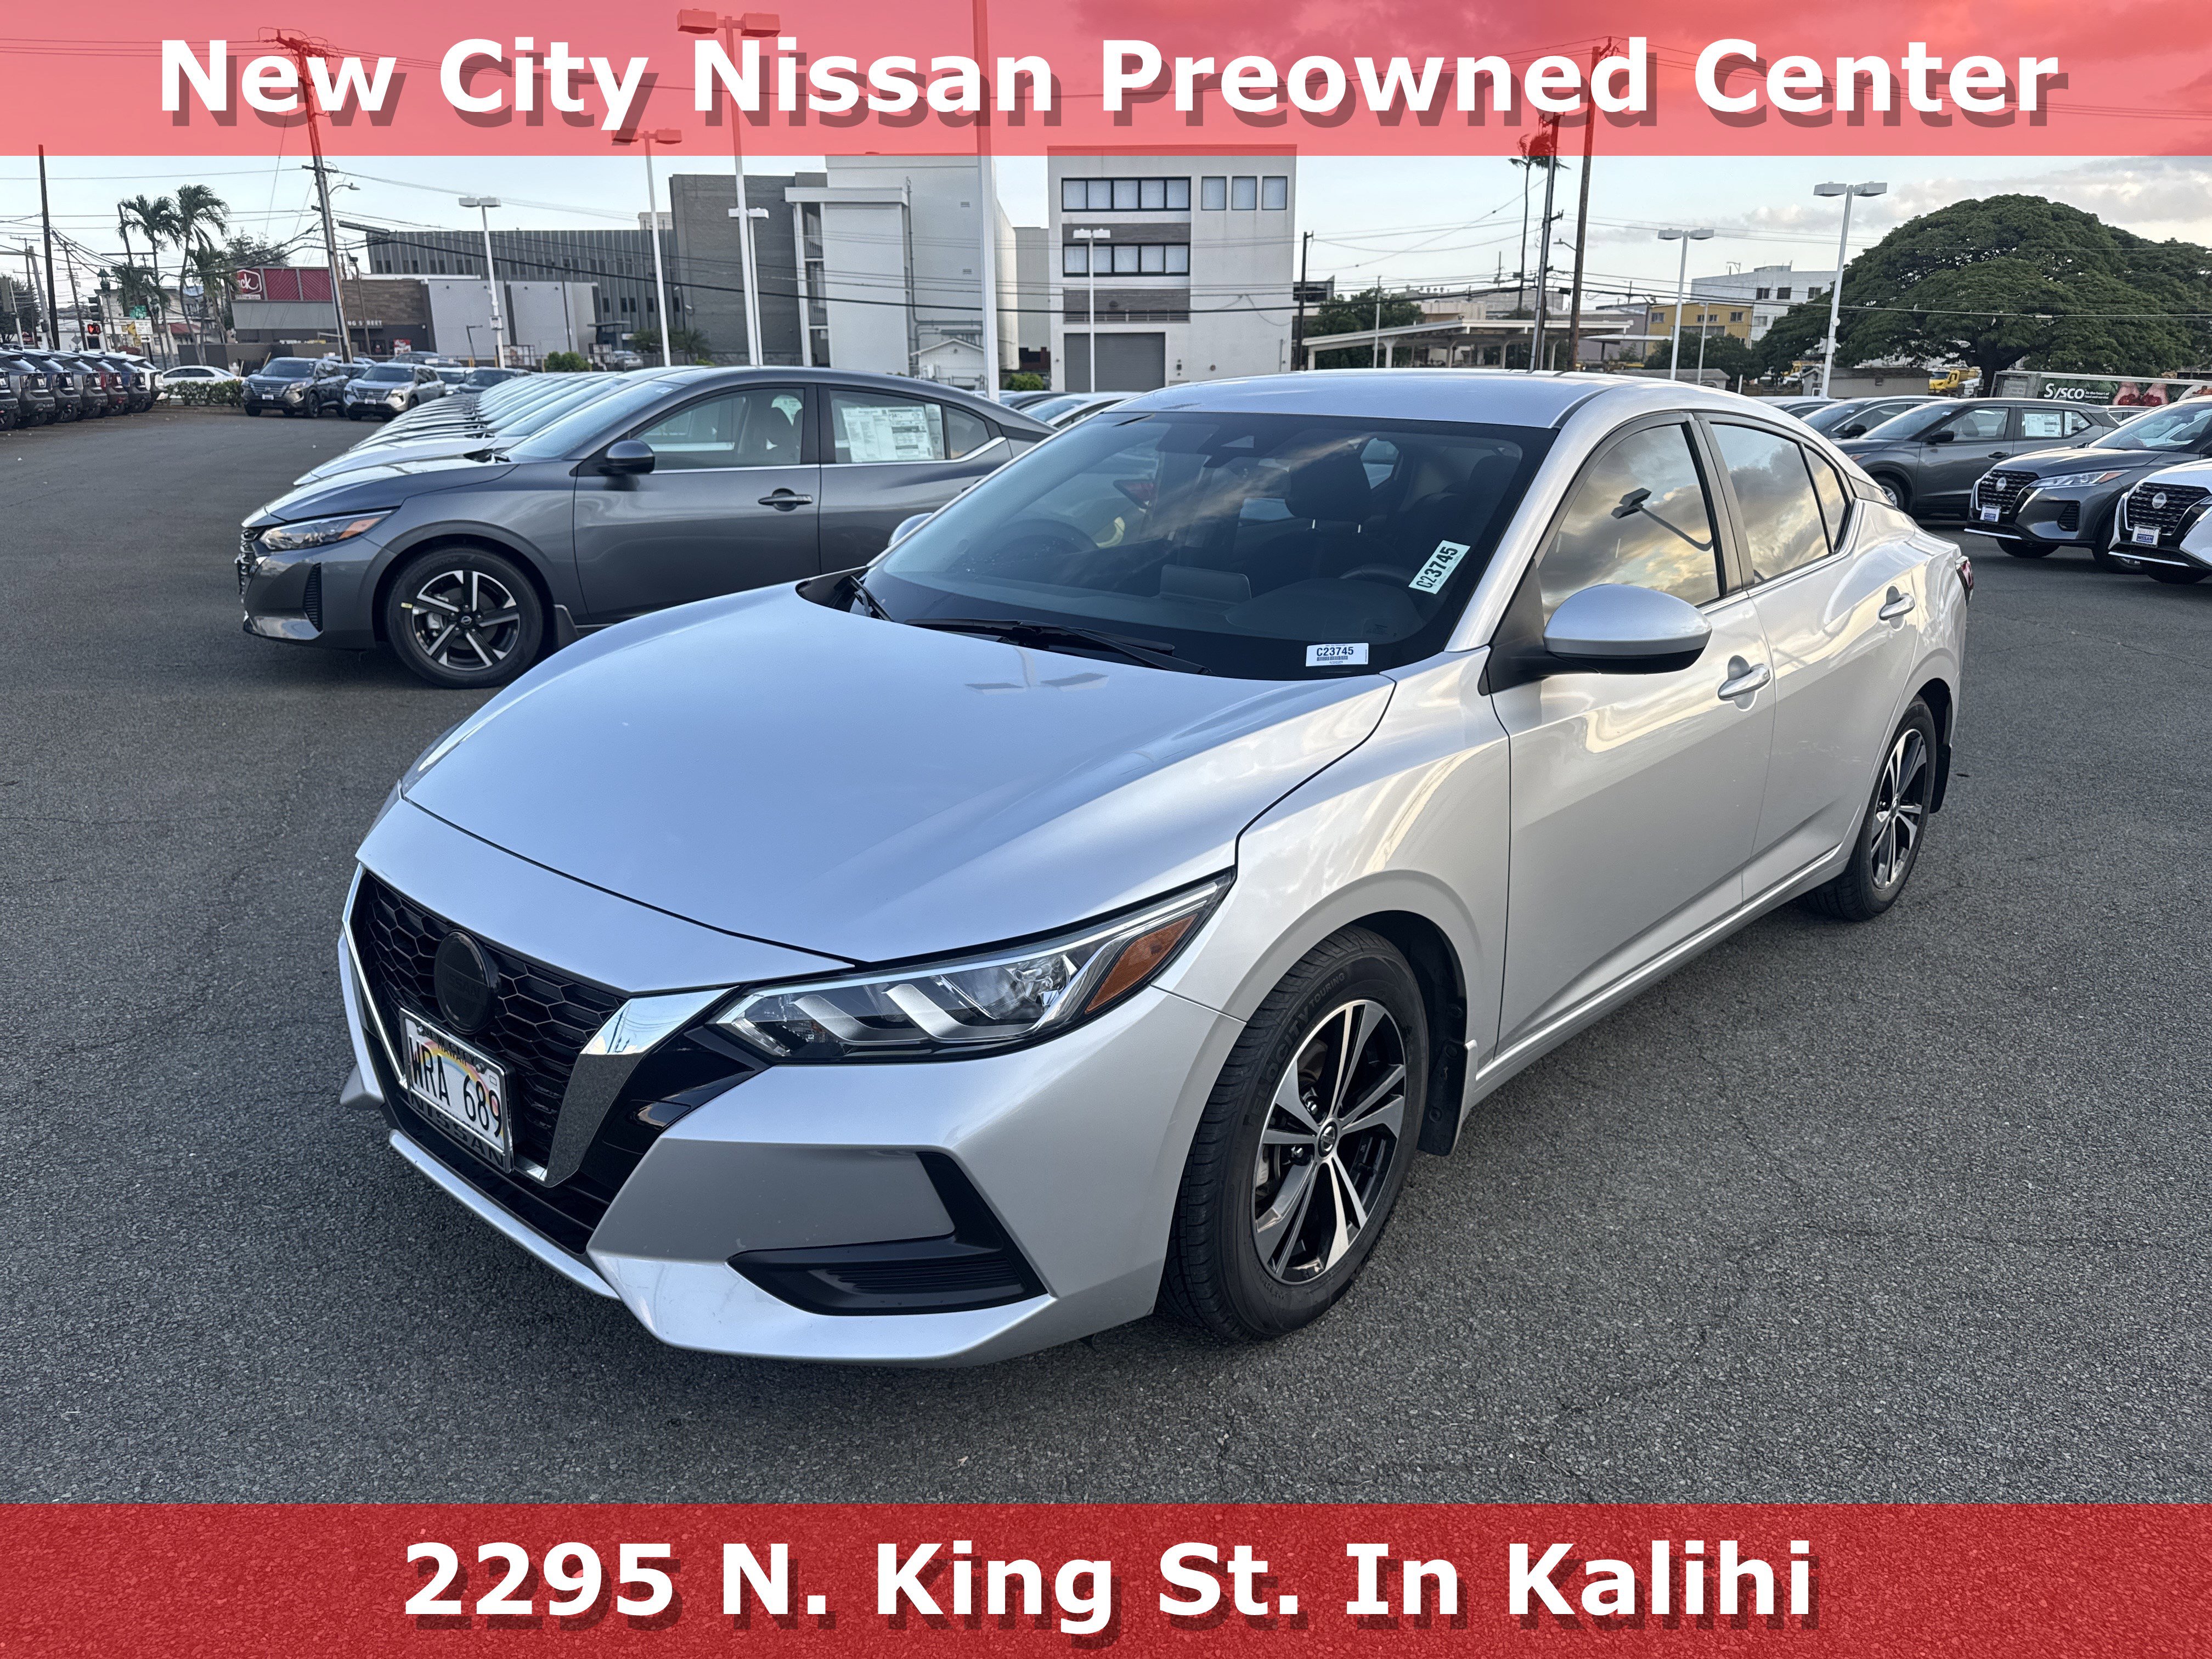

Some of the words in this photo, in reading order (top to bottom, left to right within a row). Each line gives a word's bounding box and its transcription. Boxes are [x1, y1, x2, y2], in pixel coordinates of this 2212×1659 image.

[1416, 546, 1458, 588] C23745
[1317, 647, 1353, 657] C23745
[1310, 972, 1345, 1007] TOURING
[423, 1026, 445, 1047] NEW
[409, 1035, 450, 1107] WRA
[463, 1074, 502, 1137] 689
[411, 1095, 505, 1168] NISSAN
